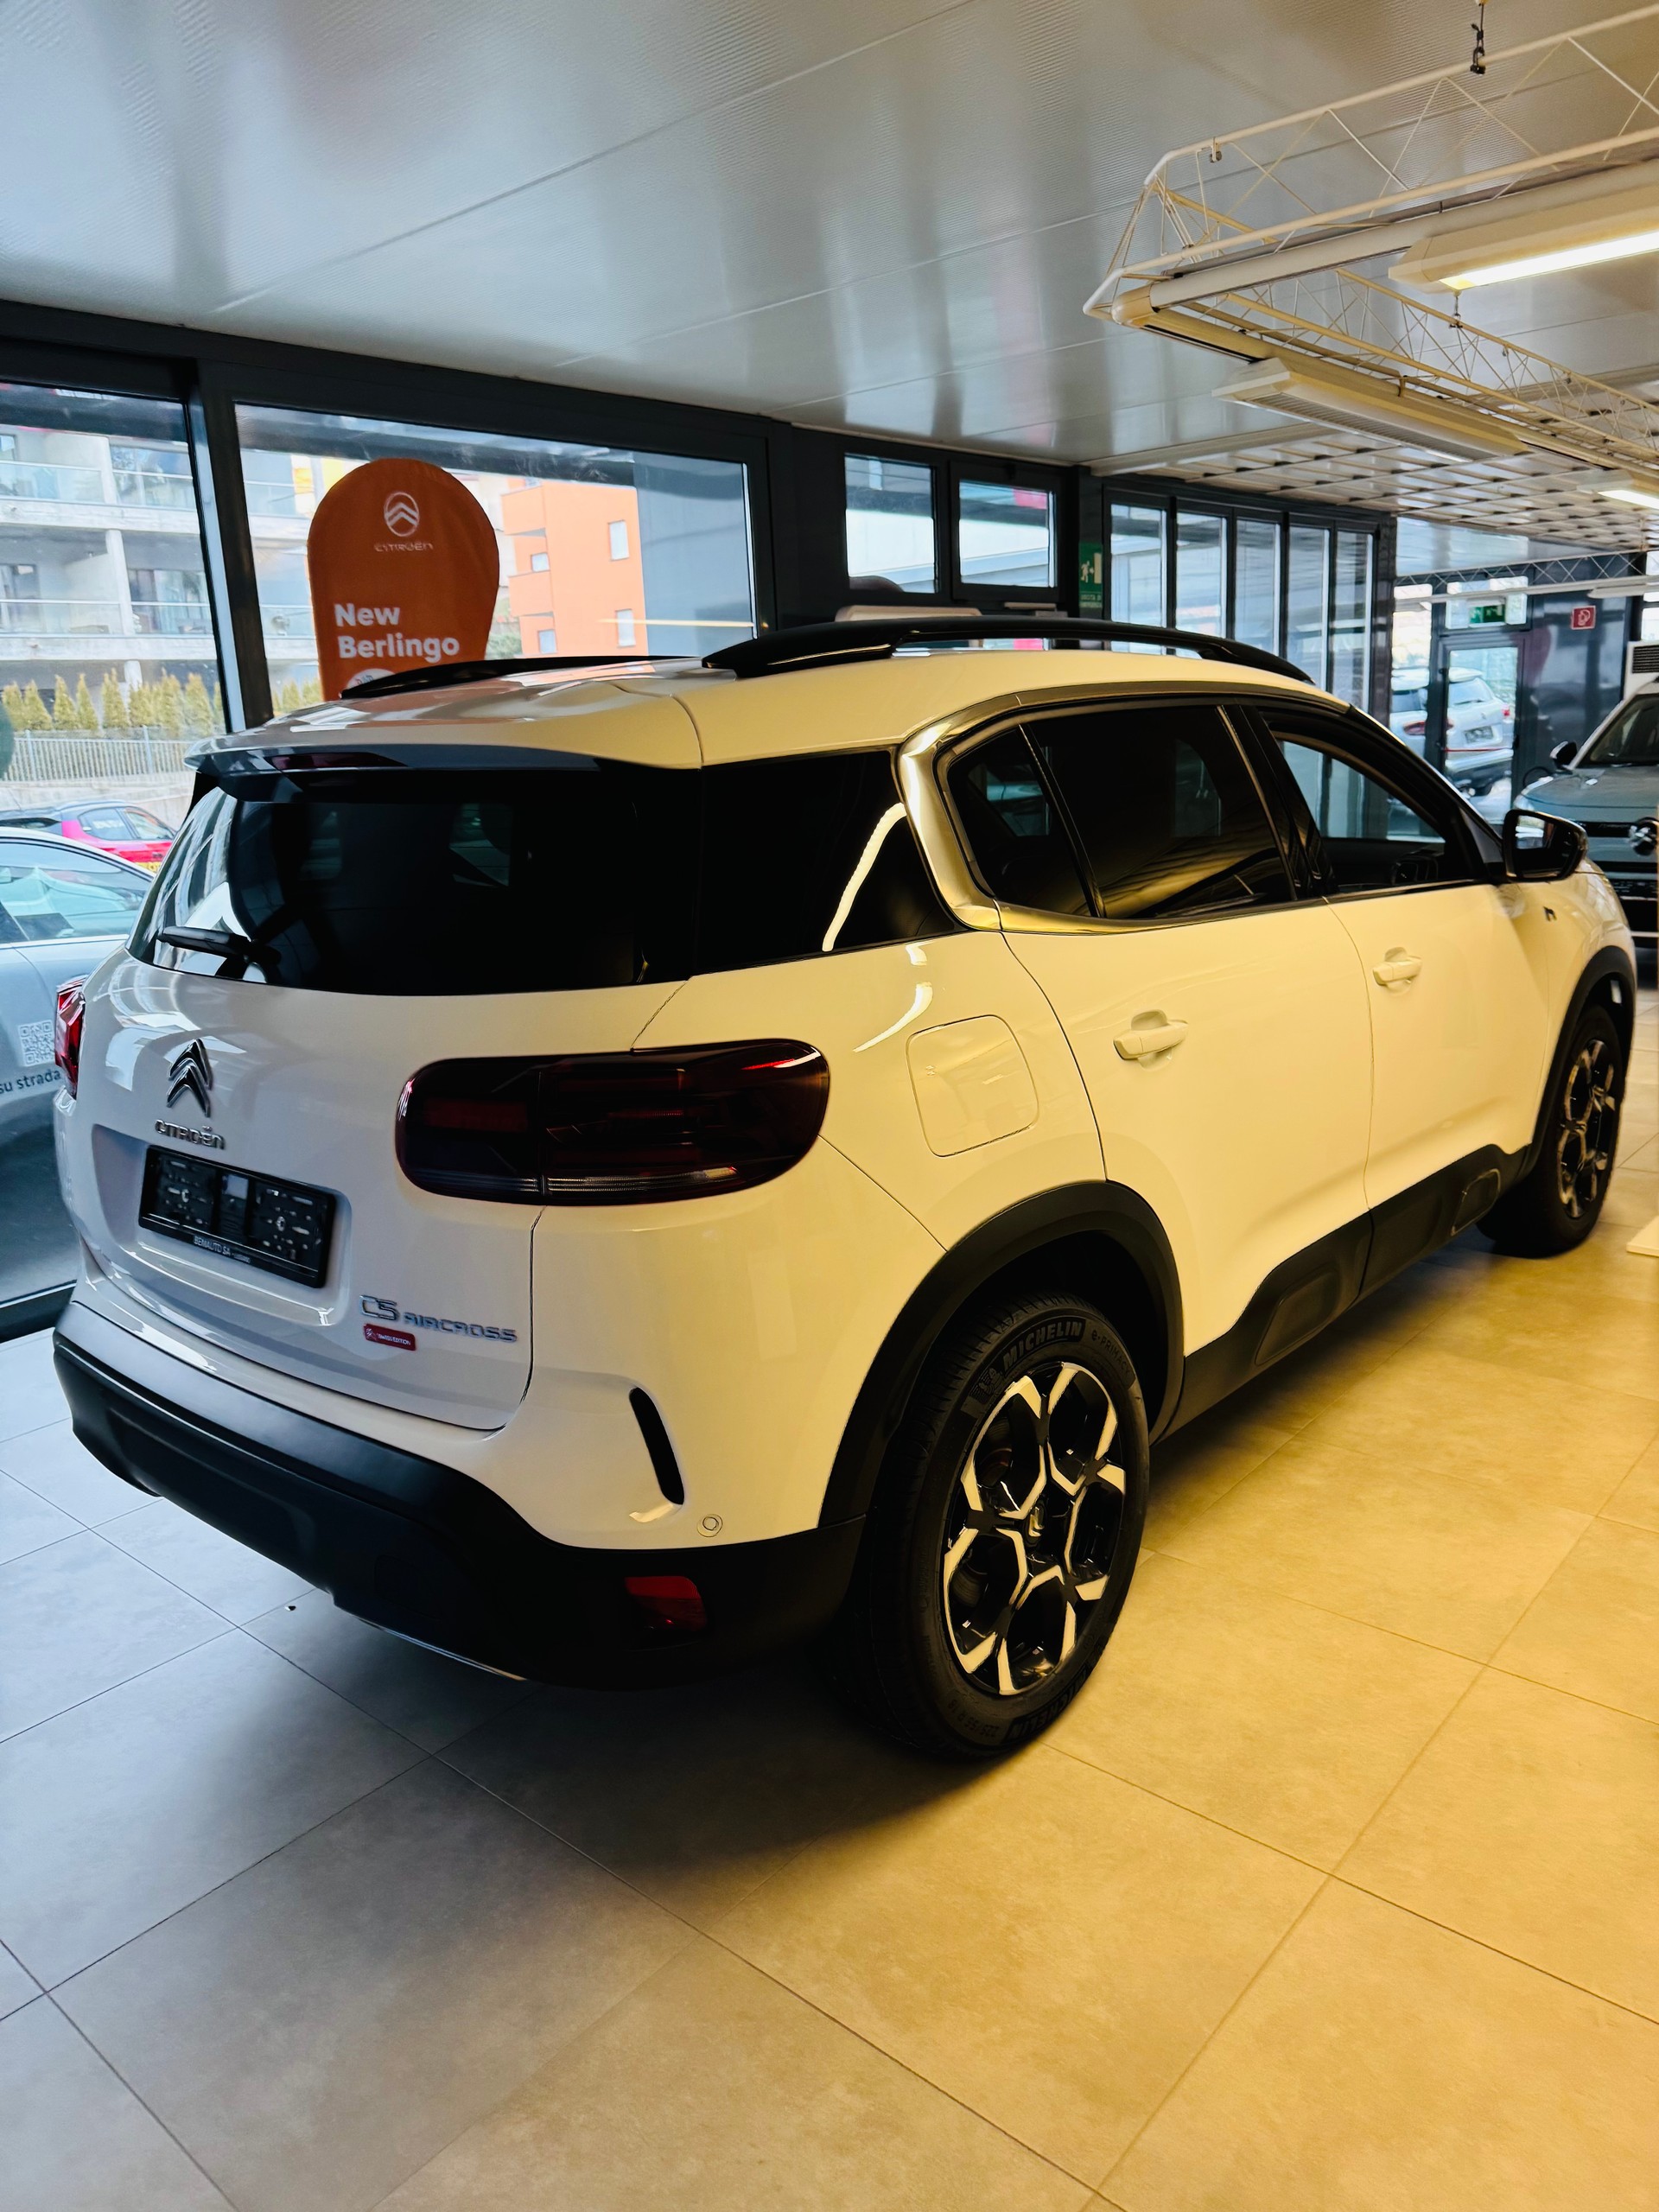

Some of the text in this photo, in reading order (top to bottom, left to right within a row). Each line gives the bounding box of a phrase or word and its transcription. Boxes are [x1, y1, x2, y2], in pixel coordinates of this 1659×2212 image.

[334, 603, 400, 627] New
[337, 632, 460, 663] Berlingo
[16, 1069, 61, 1090] strada
[359, 1294, 518, 1343] C5 AIRCROSS
[1003, 1321, 1083, 1372] MICHELIN
